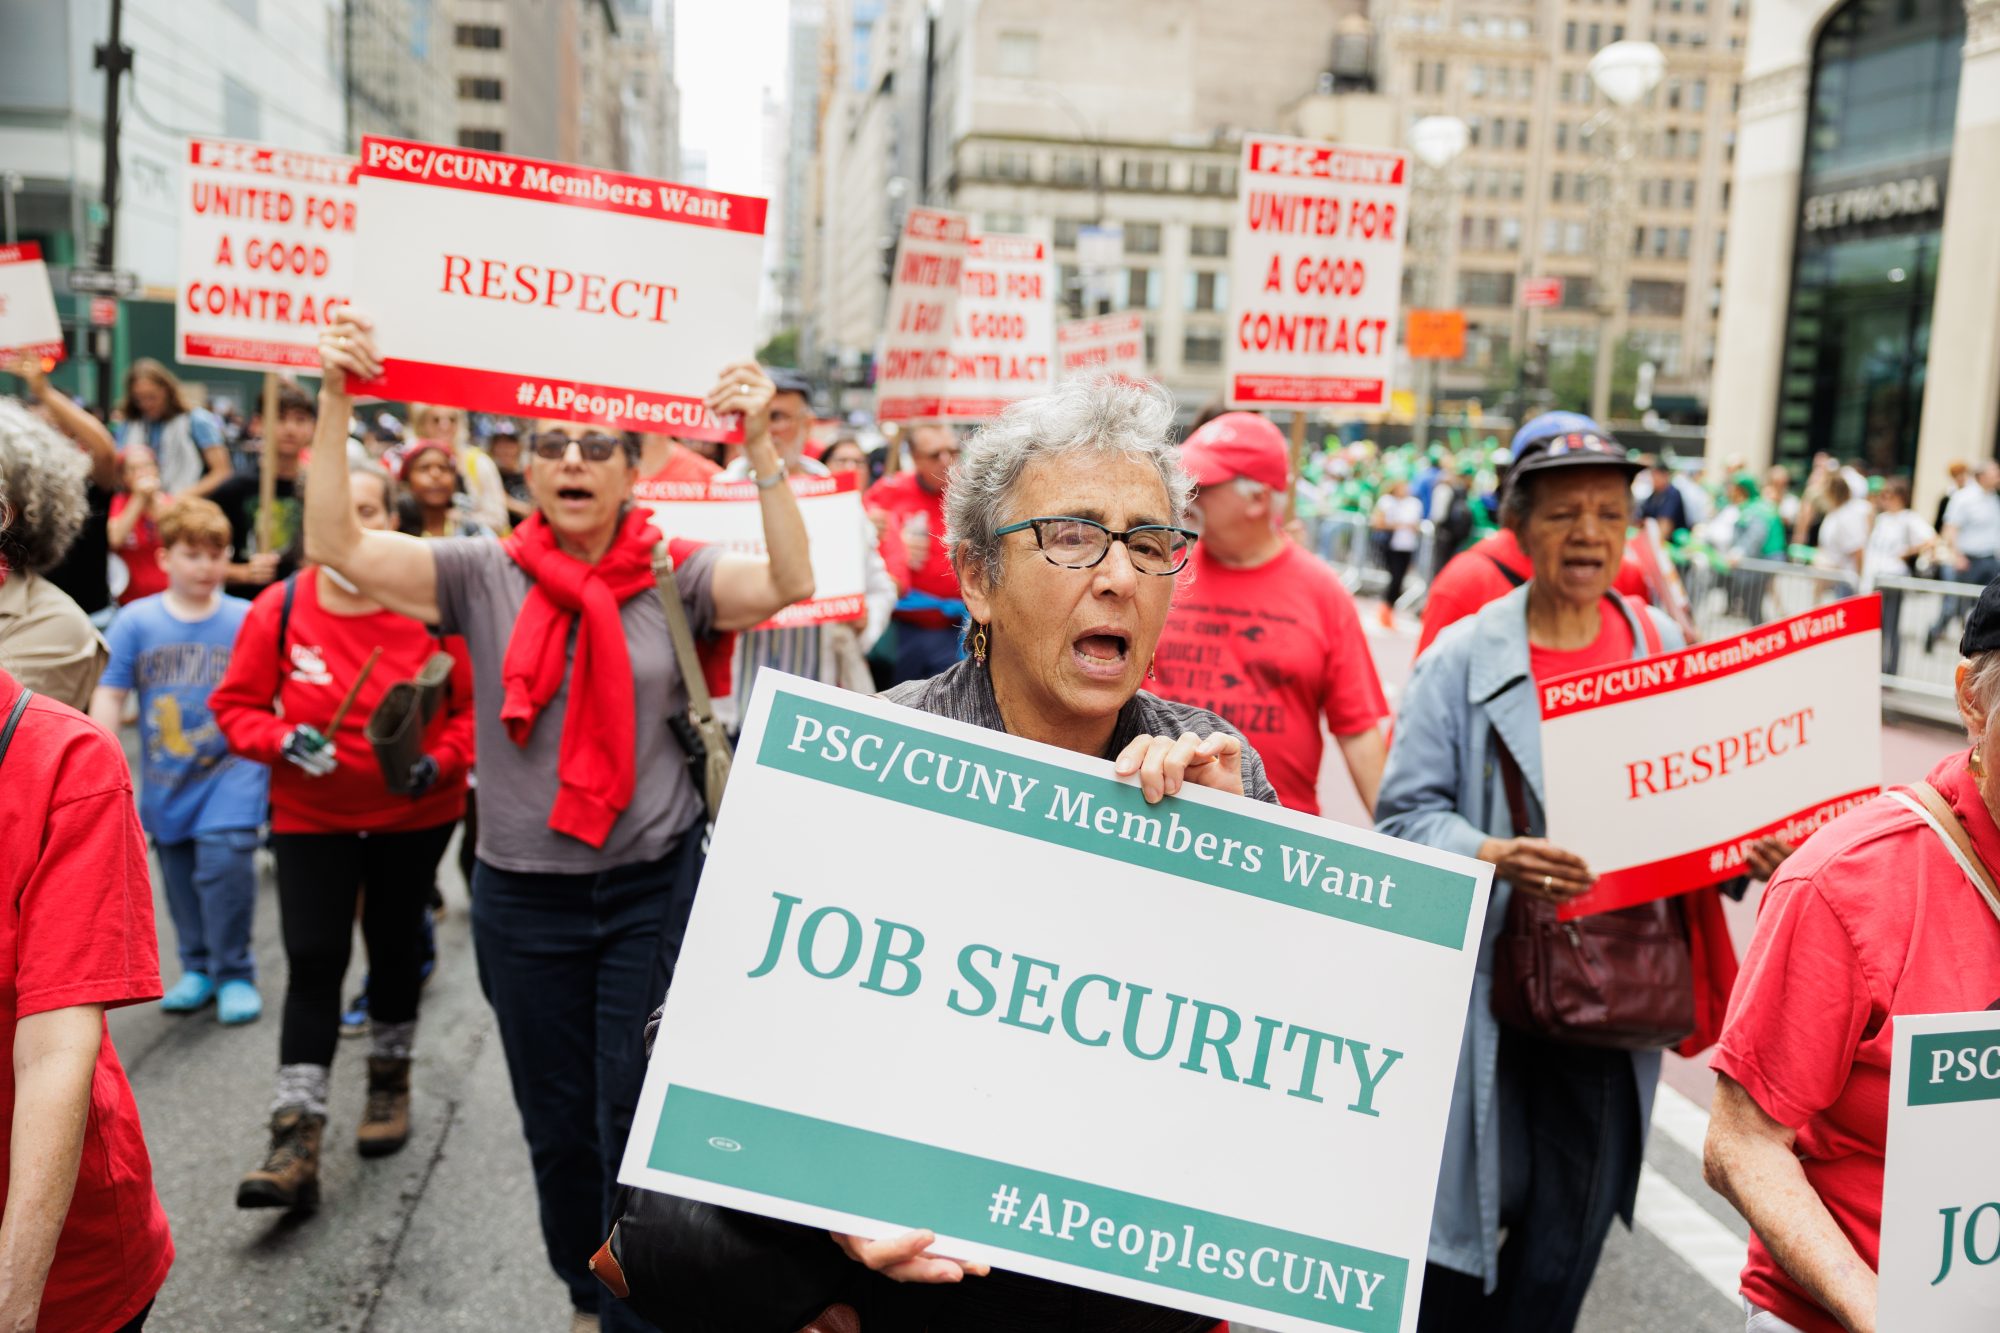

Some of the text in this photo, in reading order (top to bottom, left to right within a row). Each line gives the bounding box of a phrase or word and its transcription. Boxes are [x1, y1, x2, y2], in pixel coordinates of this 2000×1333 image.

[192, 181, 357, 233] UNITED FOR
[367, 141, 732, 221] PSC/CUNY Members Want
[1249, 191, 1396, 240] UNITED FOR
[1804, 175, 1938, 232] SEPHORA
[215, 235, 329, 277] A GOOD
[439, 253, 678, 324] RESPECT
[1264, 253, 1365, 296] A GOOD
[187, 281, 350, 326] CONTRAC
[1238, 312, 1388, 354] CONTRACT
[1545, 608, 1847, 711] PSC/CUNY Members Want
[1624, 707, 1815, 801] RESPECT
[788, 715, 1399, 909] PSC/CUNY Members Want
[747, 891, 1404, 1118] JOB SECURITY
[988, 1183, 1386, 1312] #APeoplesCUNY
[1931, 1202, 2000, 1287] JO
